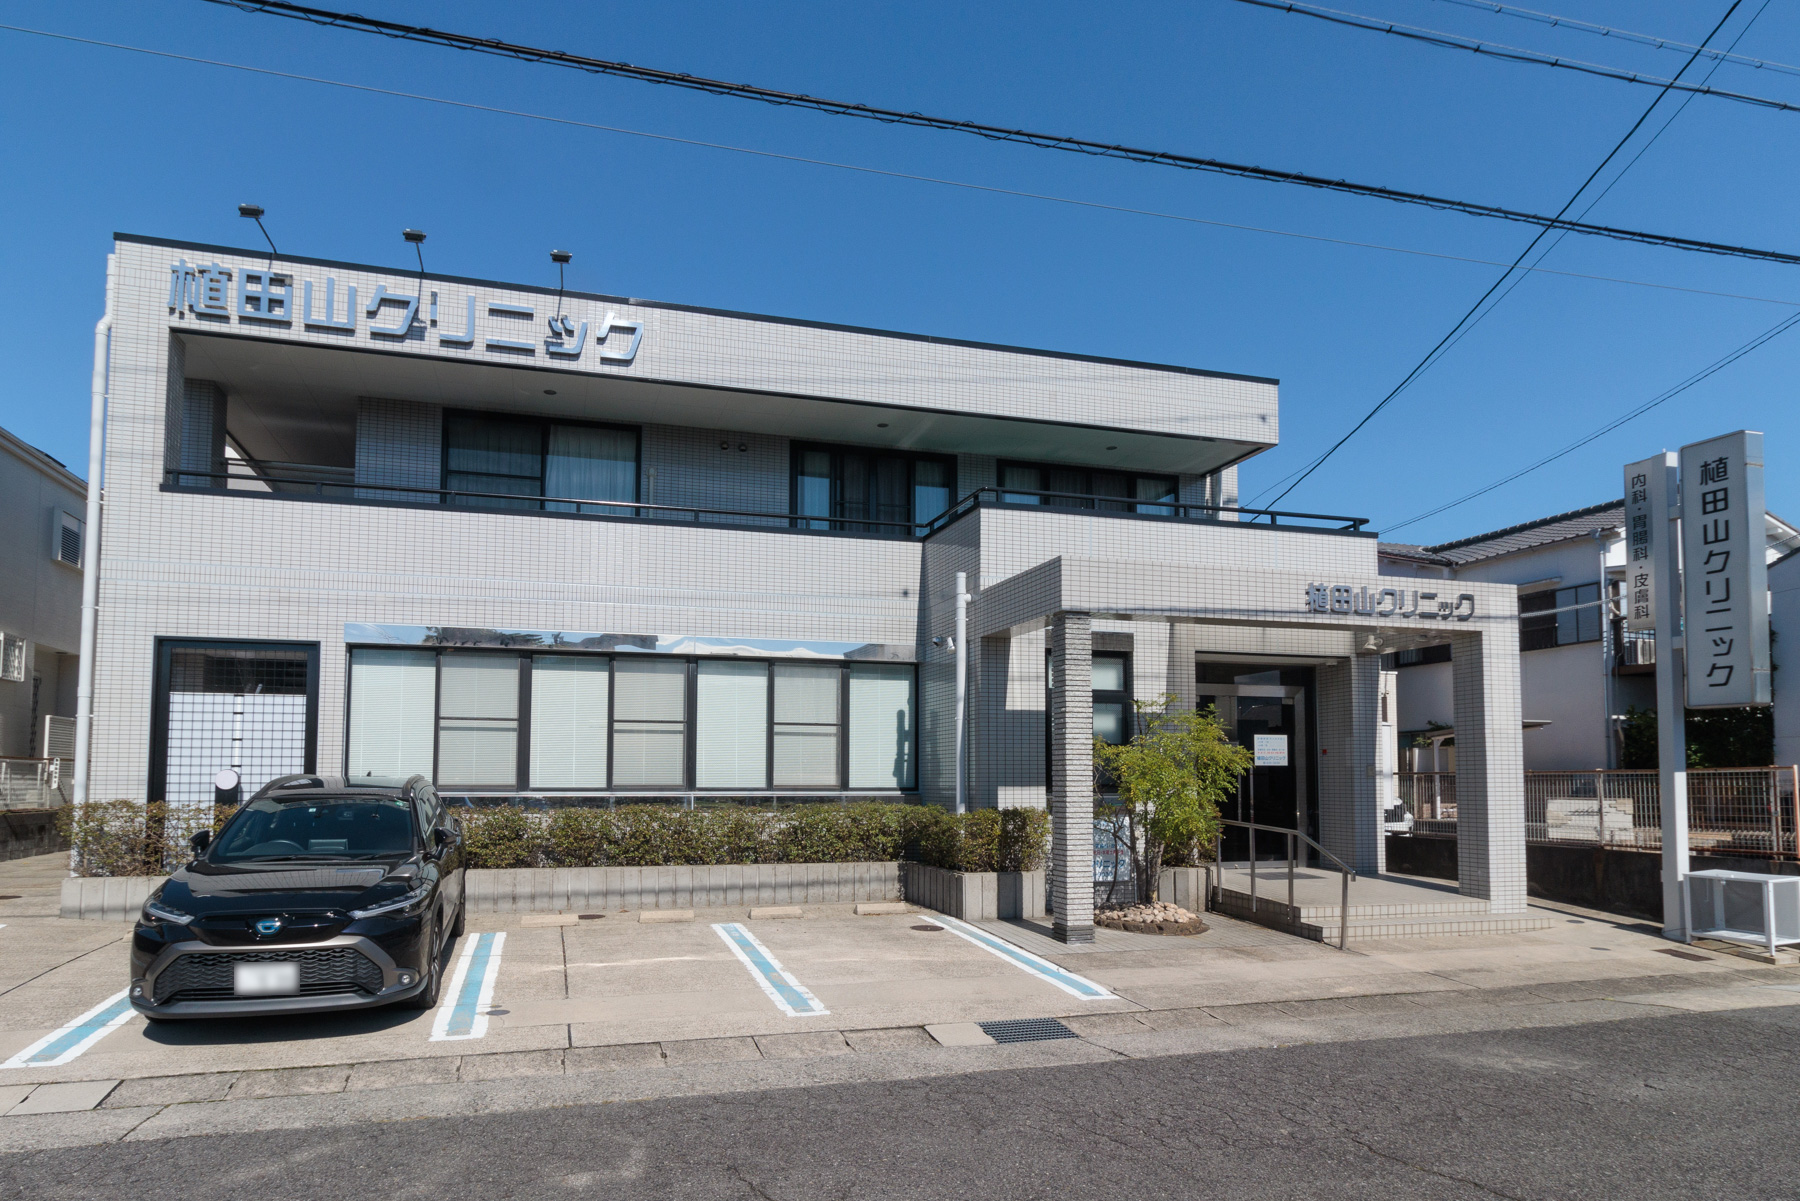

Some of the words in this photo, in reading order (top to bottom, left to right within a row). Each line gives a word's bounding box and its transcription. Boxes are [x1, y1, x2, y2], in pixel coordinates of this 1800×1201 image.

[168, 258, 644, 361] 植田山クリニック
[1305, 582, 1475, 621] 植田山クリニック
[1631, 473, 1650, 619] 内科・胃腸科・皮膚科
[1699, 456, 1734, 687] 植田山クリニック
